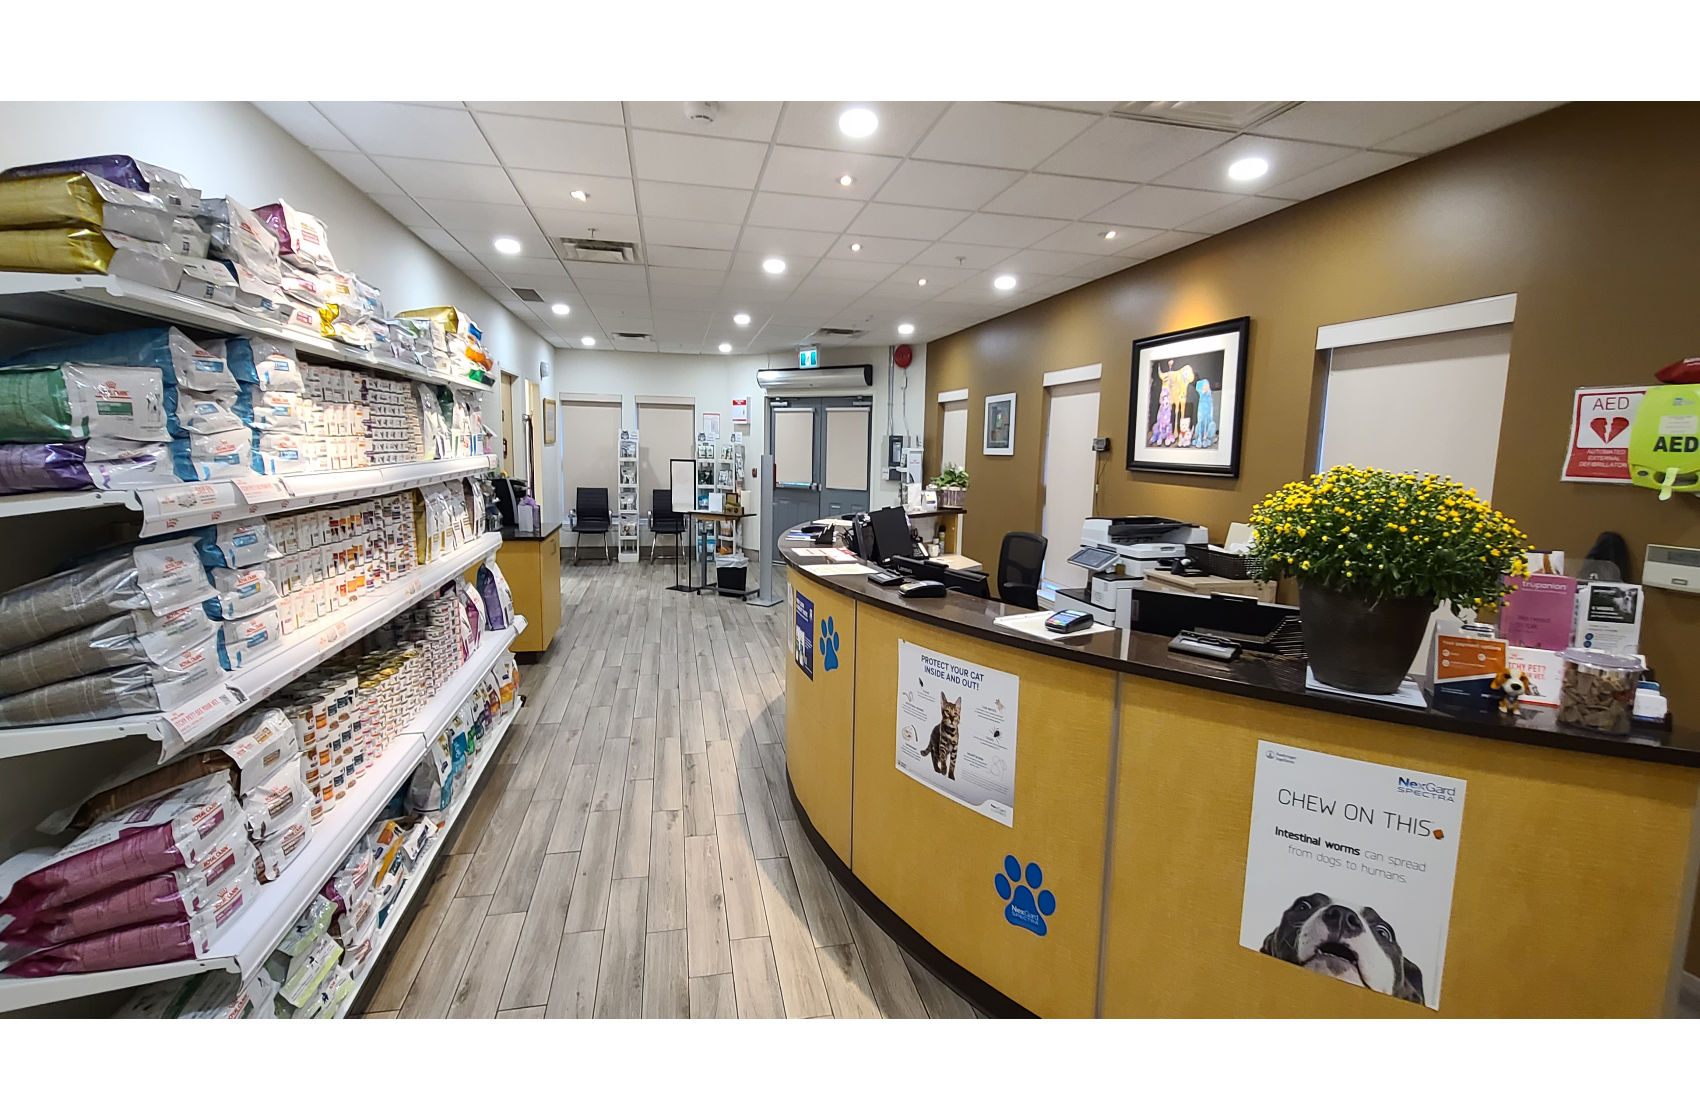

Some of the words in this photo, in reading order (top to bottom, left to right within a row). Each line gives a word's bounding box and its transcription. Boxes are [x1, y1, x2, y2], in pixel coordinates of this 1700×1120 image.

[1592, 396, 1630, 411] AED
[1653, 436, 1699, 453] AED
[1521, 580, 1567, 591] trupanion
[920, 654, 950, 671] PROTECT
[950, 664, 969, 677] YOUR
[970, 671, 985, 683] CAT
[924, 665, 946, 680] INSIDE
[945, 674, 961, 685] AND
[961, 678, 980, 691] OUT!
[1397, 786, 1455, 803] SPECTRA
[1398, 776, 1457, 797] NexGard
[1277, 788, 1337, 816] CHEW
[1344, 803, 1375, 825] ON
[1383, 811, 1432, 837] THIS
[1275, 826, 1322, 847] Intestinal
[1325, 839, 1361, 856] worms
[1364, 850, 1384, 862] can
[1387, 854, 1427, 873] spread
[1288, 844, 1312, 859] from
[1316, 852, 1342, 868] dogs
[1346, 859, 1357, 871] to
[1360, 862, 1408, 883] humans.
